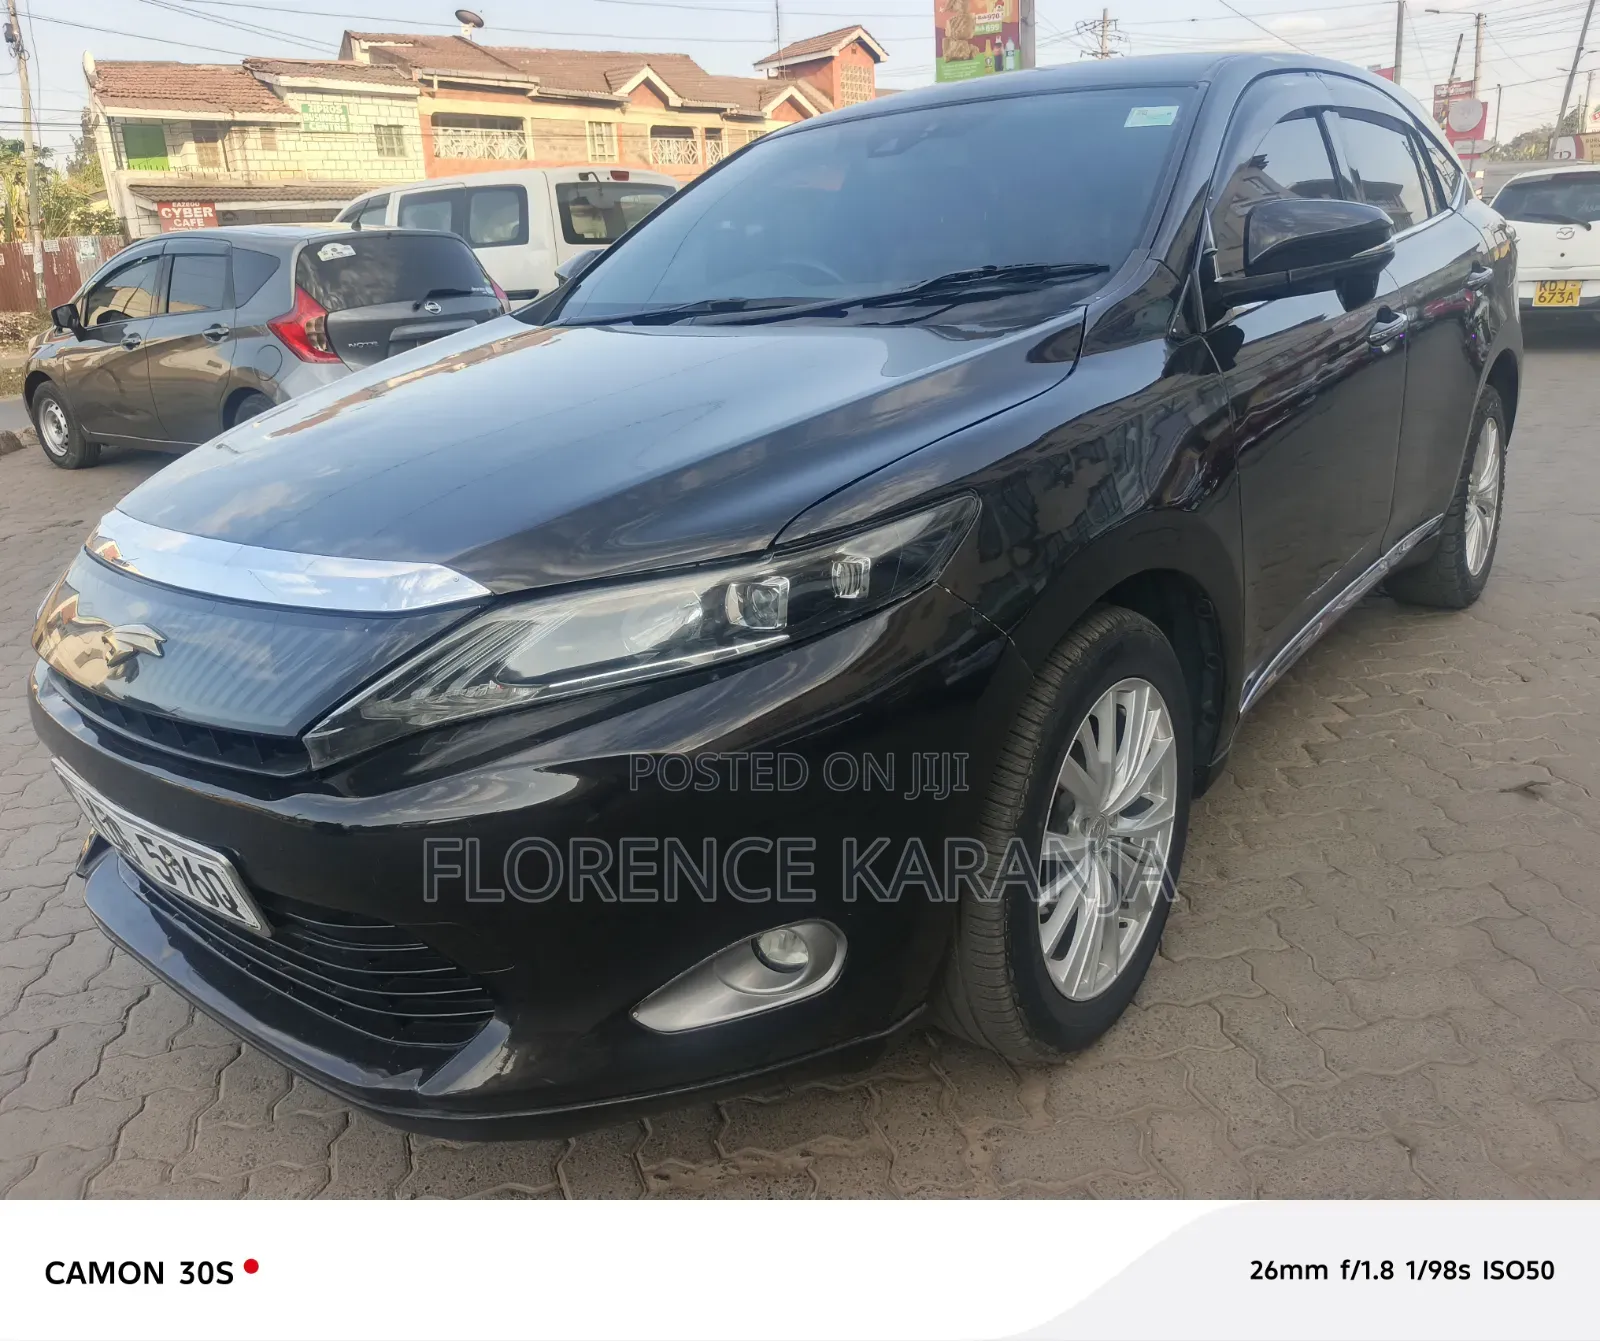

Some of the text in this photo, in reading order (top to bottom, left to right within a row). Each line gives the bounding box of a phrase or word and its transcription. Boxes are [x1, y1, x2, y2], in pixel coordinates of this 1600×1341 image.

[303, 112, 347, 122] BUSINESS
[308, 122, 347, 131] CENTRE
[161, 206, 213, 218] CYBER
[173, 218, 204, 226] CAFE
[1539, 280, 1567, 292] KDJ
[1537, 292, 1574, 304] 673A
